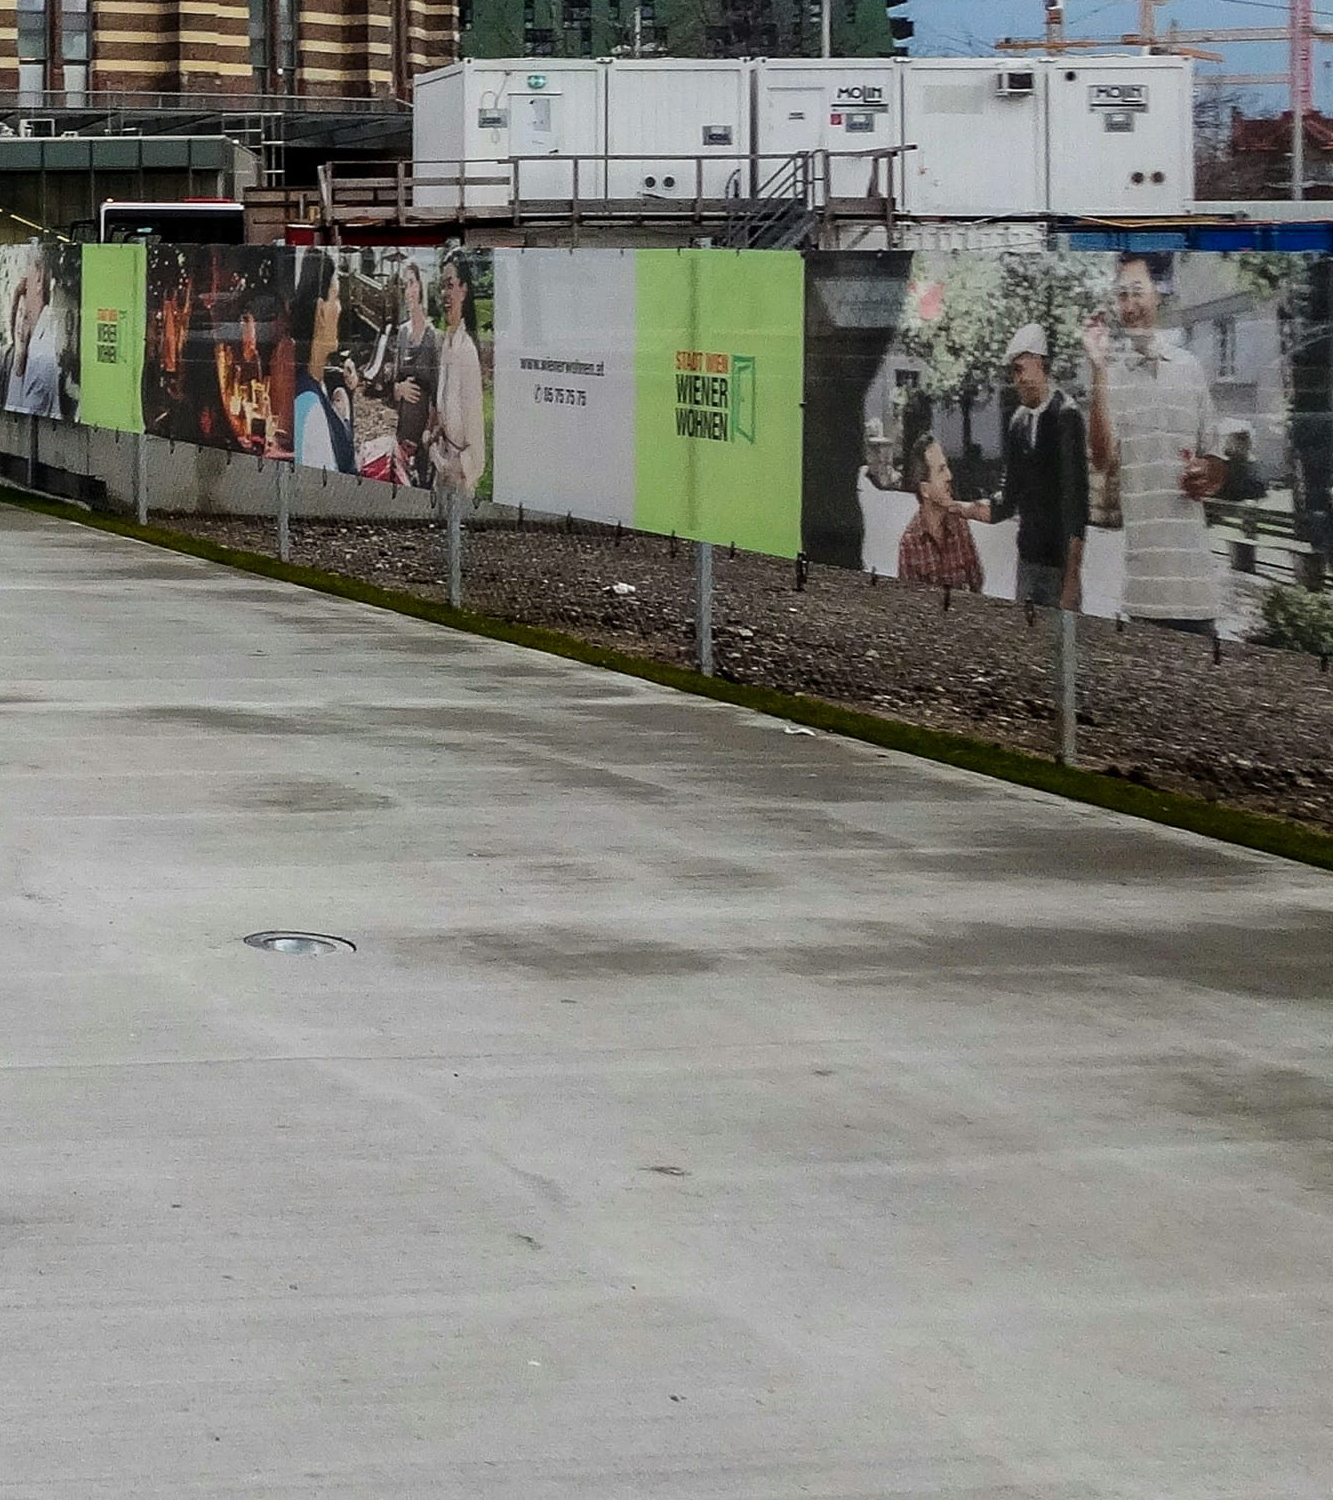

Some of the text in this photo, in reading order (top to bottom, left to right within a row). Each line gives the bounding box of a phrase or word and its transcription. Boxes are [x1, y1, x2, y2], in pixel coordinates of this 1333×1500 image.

[837, 85, 882, 103] MOLIN
[1096, 87, 1142, 103] MOLIN
[675, 373, 728, 409] WIENER
[675, 407, 728, 442] WOHNEN
